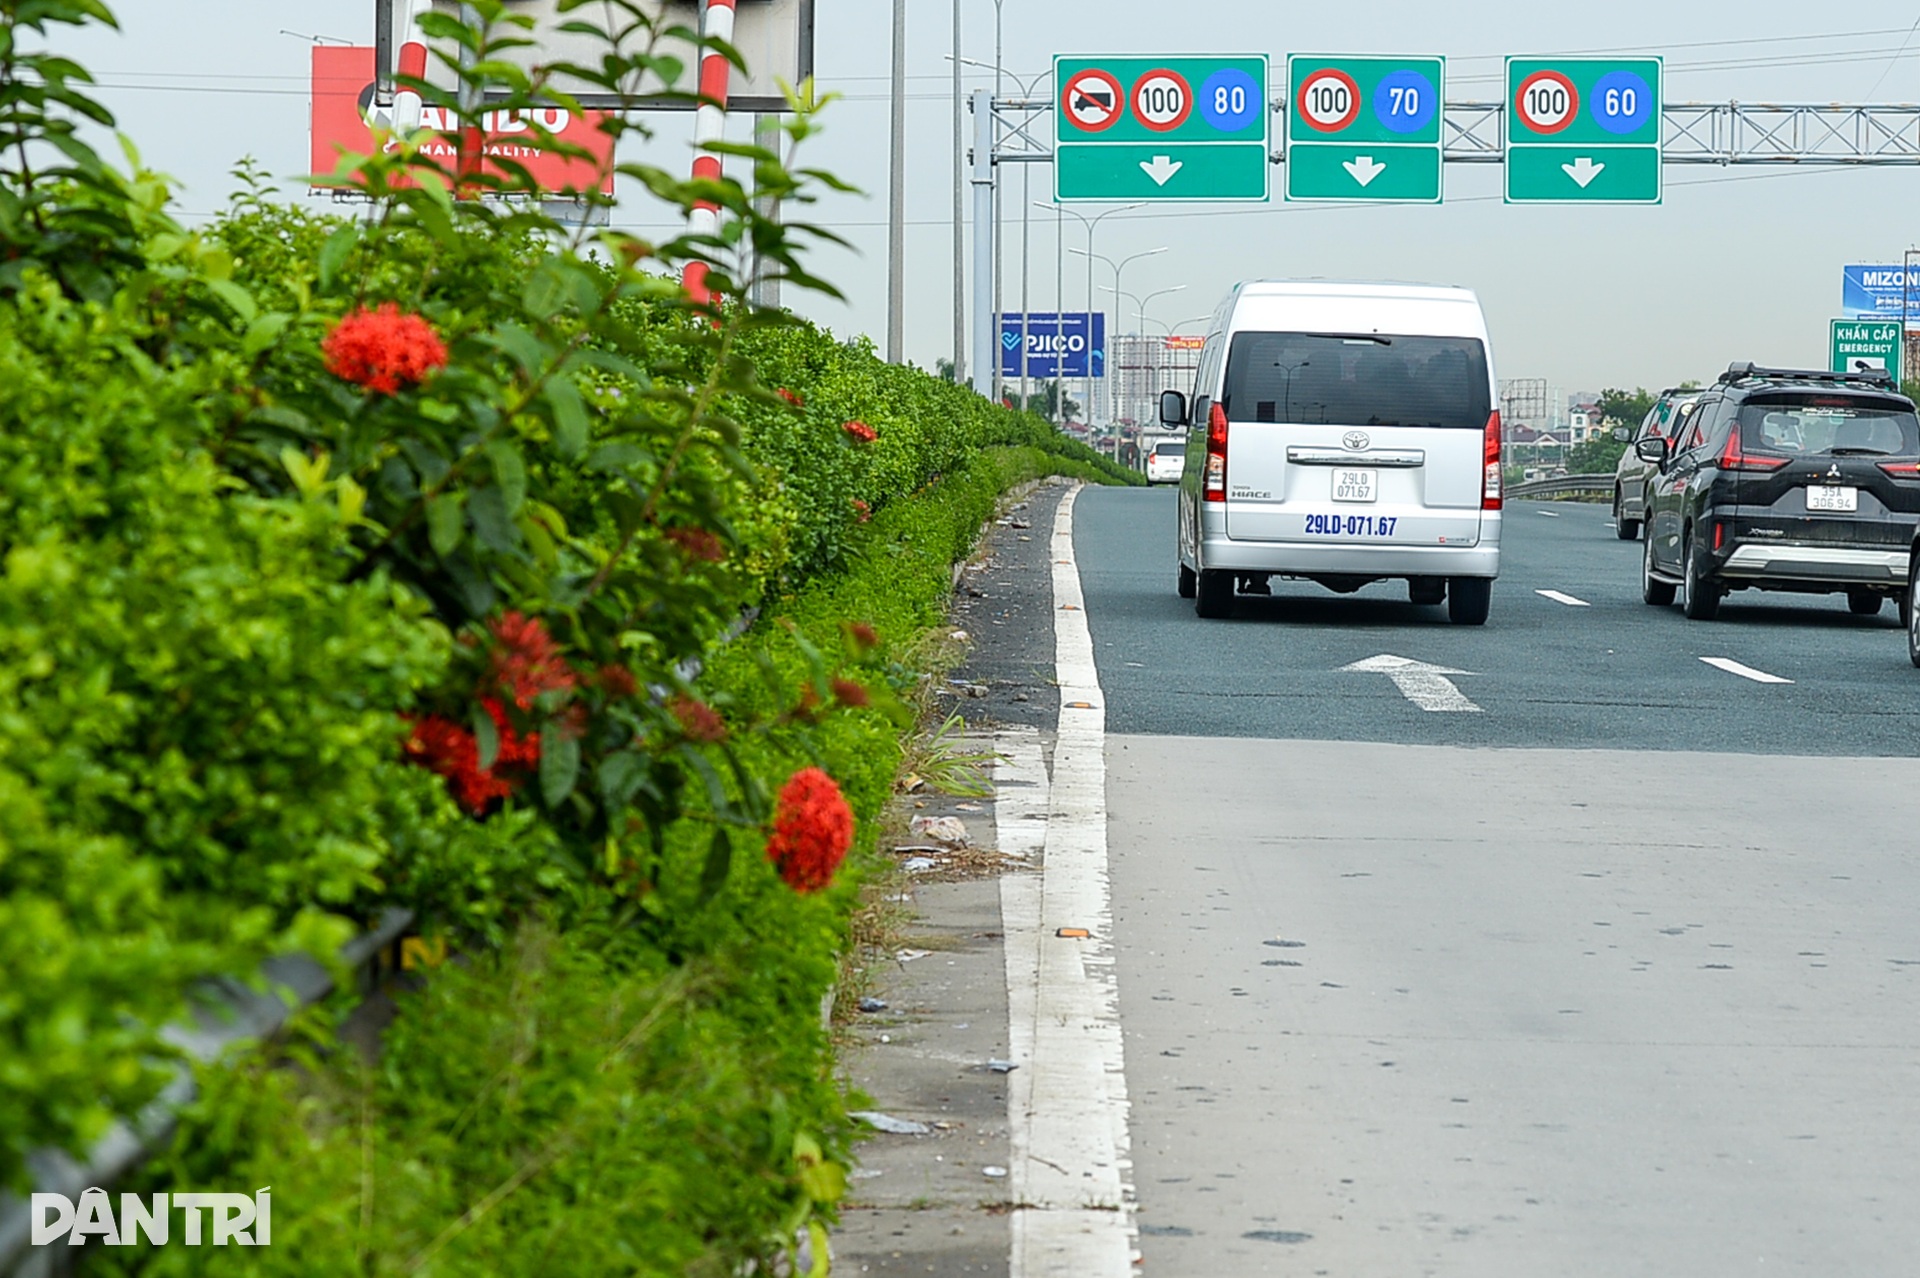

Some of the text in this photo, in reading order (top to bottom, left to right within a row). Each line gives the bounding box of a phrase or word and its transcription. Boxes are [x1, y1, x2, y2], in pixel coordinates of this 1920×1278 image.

[1143, 86, 1246, 114] 100 80
[1311, 87, 1419, 116] 100 70
[1529, 89, 1636, 117] 100 60
[1862, 271, 1920, 287] MIZON
[1837, 323, 1896, 341] KHẤN CẤP
[1025, 334, 1085, 352] PJICO
[1839, 343, 1892, 353] EMERGENCY
[1342, 472, 1368, 485] 29LD
[1231, 491, 1272, 499] HIACE
[1337, 486, 1371, 499] 071.67
[1821, 486, 1843, 498] 35A
[1813, 498, 1851, 509] 306.94
[1305, 514, 1397, 536] 29LD-071.67
